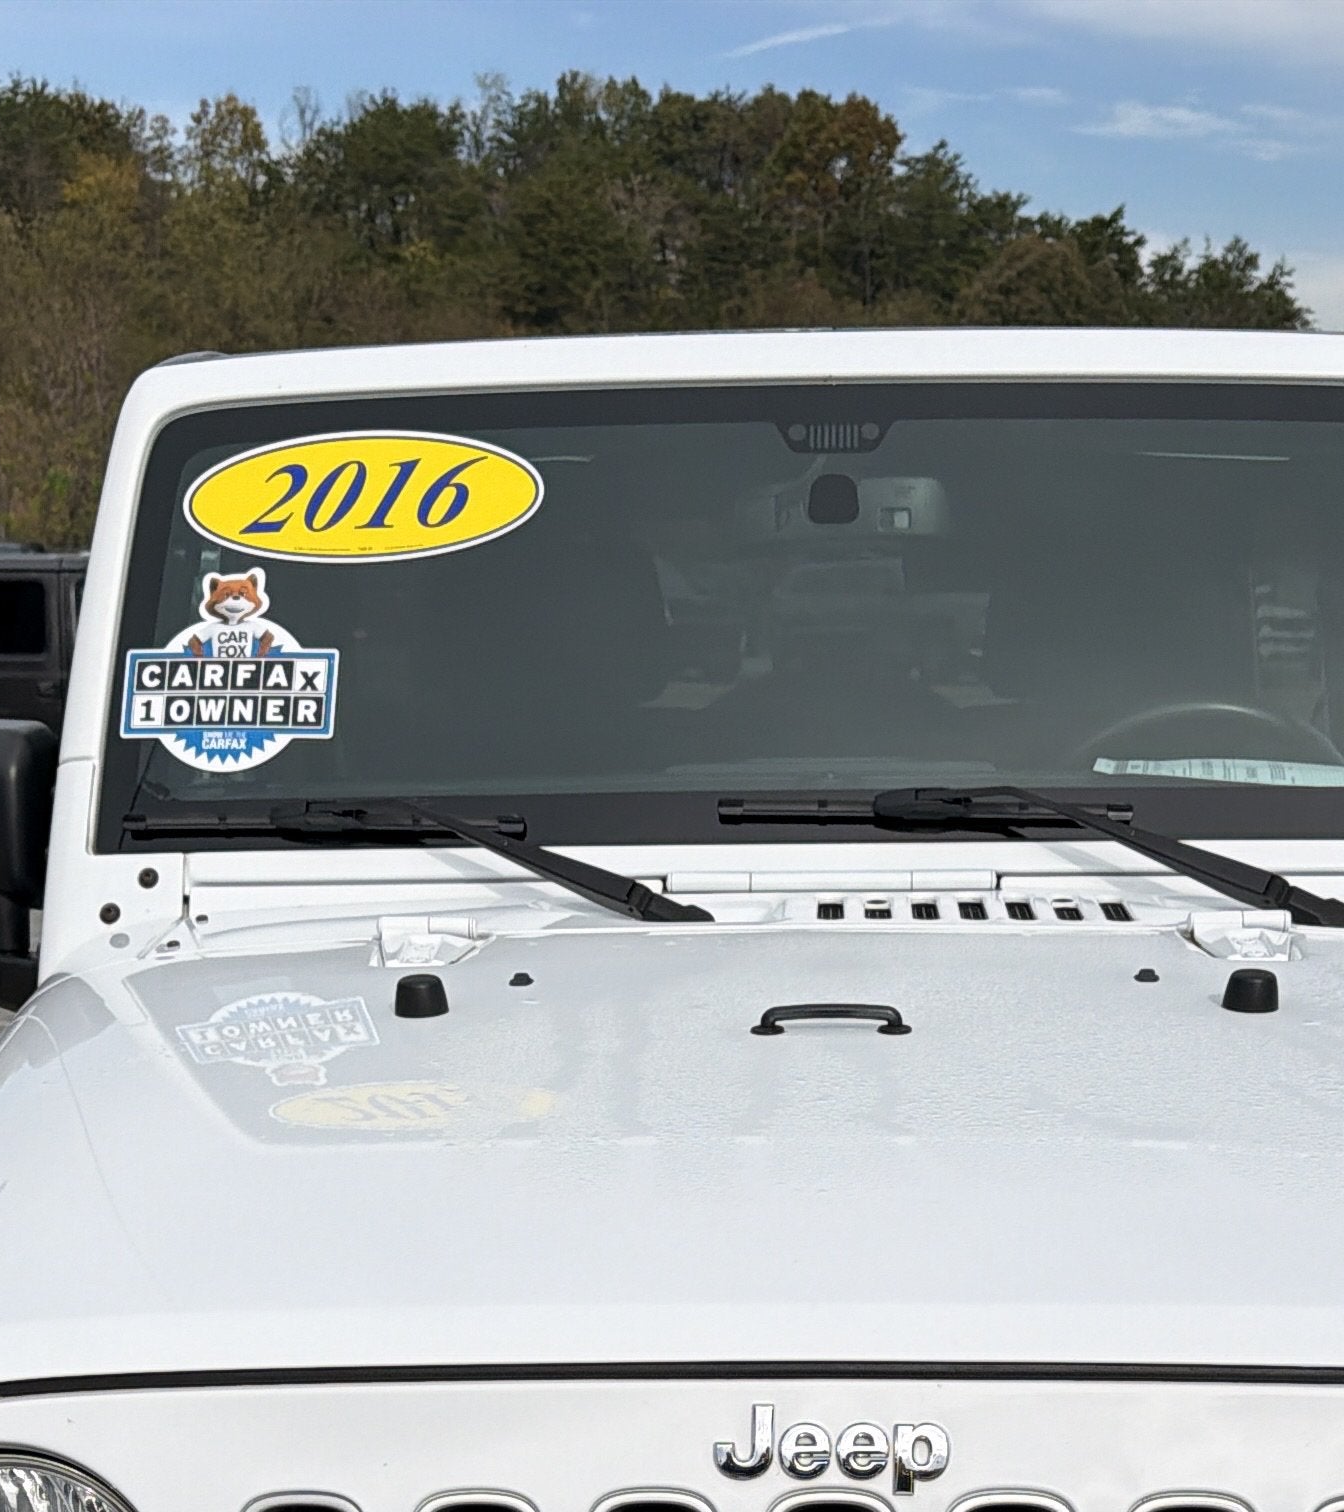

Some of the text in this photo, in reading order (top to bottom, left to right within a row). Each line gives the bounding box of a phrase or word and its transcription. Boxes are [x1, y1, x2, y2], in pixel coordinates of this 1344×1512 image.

[239, 455, 489, 535] 2016
[217, 631, 248, 645] CAR
[217, 645, 247, 658] FOX
[141, 662, 321, 692] CARFAX
[139, 698, 319, 723] 1 OWNER
[201, 739, 247, 750] CARFAX
[712, 1402, 952, 1496] Jeep
